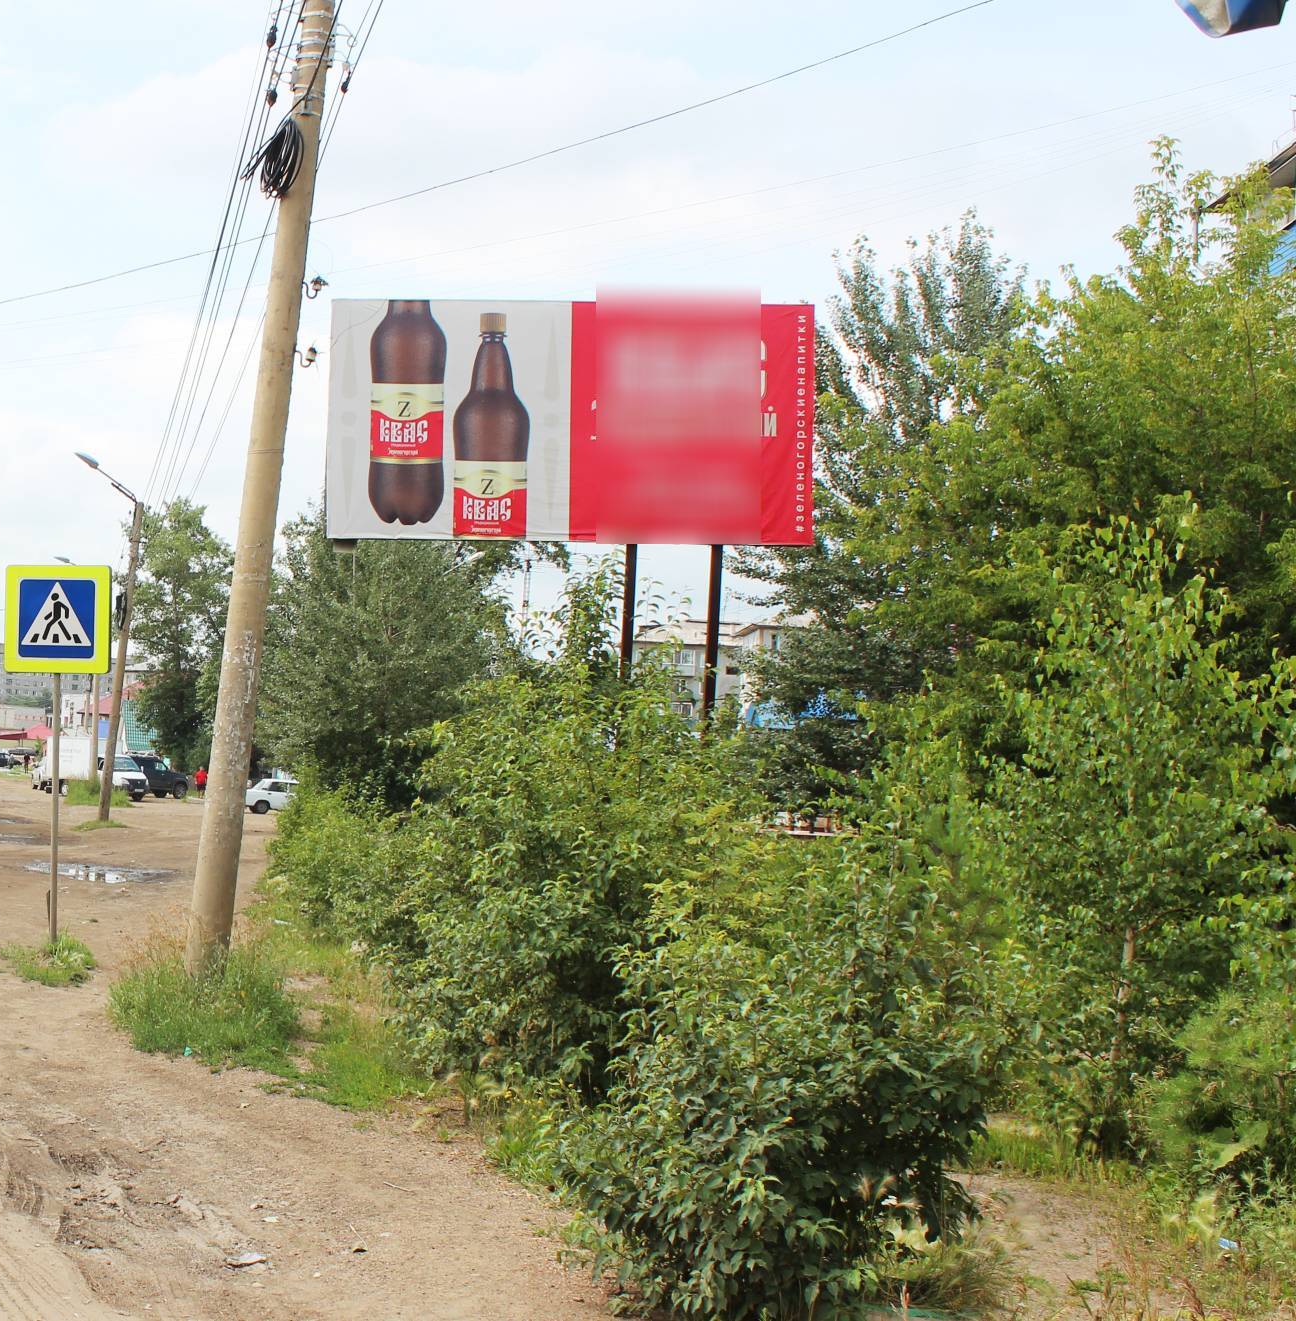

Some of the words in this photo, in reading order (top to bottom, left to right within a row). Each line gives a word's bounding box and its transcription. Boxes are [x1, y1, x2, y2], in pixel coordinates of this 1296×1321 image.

[397, 401, 412, 418] Z
[379, 418, 429, 444] КВАС
[795, 314, 807, 533] #зеленогорскиенапитки
[480, 478, 494, 495] Z
[462, 496, 512, 522] КВАС
